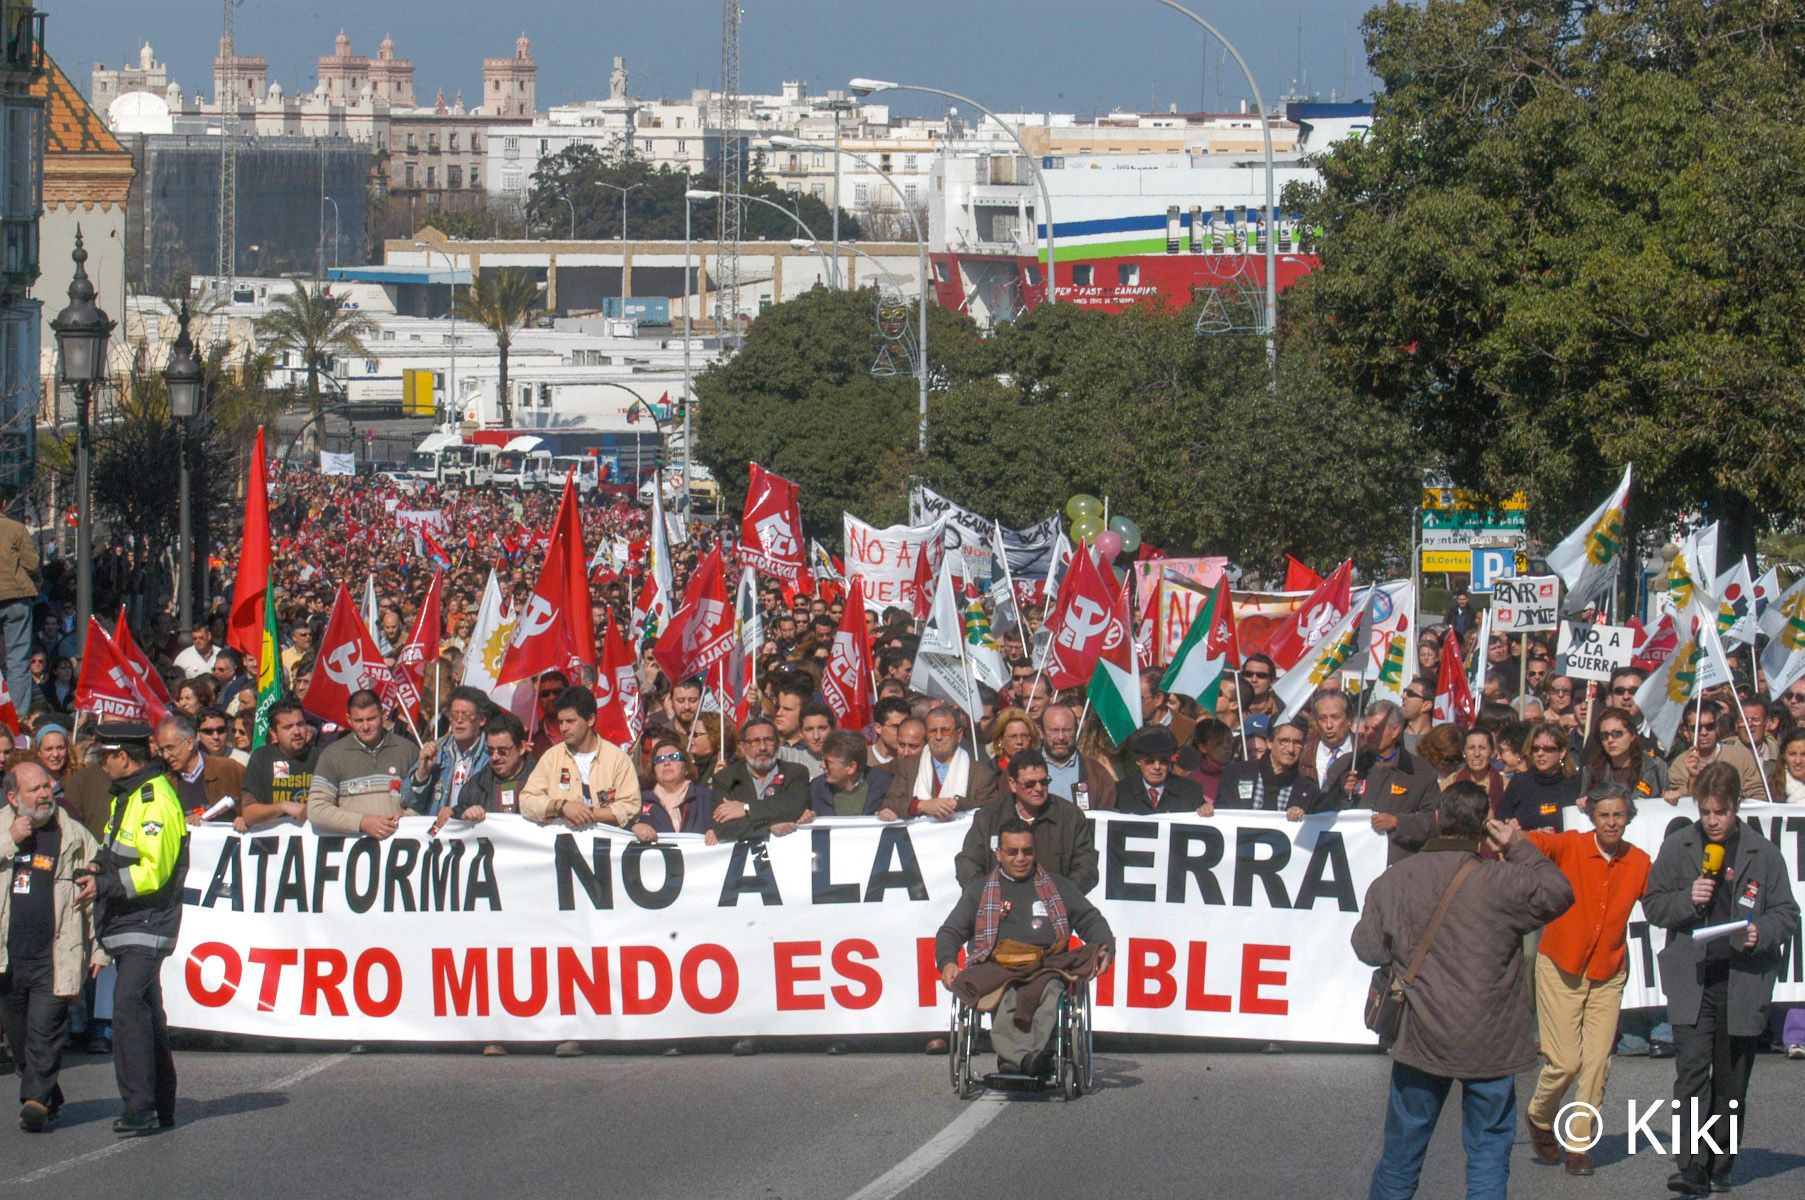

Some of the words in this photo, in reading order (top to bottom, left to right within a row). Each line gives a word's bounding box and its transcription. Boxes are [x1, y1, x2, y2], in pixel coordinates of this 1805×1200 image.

[1044, 286, 1072, 296] SPER
[849, 526, 884, 565] NO
[897, 540, 911, 568] A
[1483, 552, 1504, 589] P
[1493, 582, 1538, 604] AZNAR
[1573, 627, 1600, 643] NO
[1609, 632, 1620, 647] A
[1585, 643, 1604, 657] LA
[1565, 653, 1620, 673] GUERRA
[554, 832, 685, 911] NO
[717, 839, 784, 907] A
[811, 827, 930, 904] LA
[184, 941, 403, 1018] OTRO
[431, 942, 740, 1018] MUNDO
[773, 937, 884, 1011] ES
